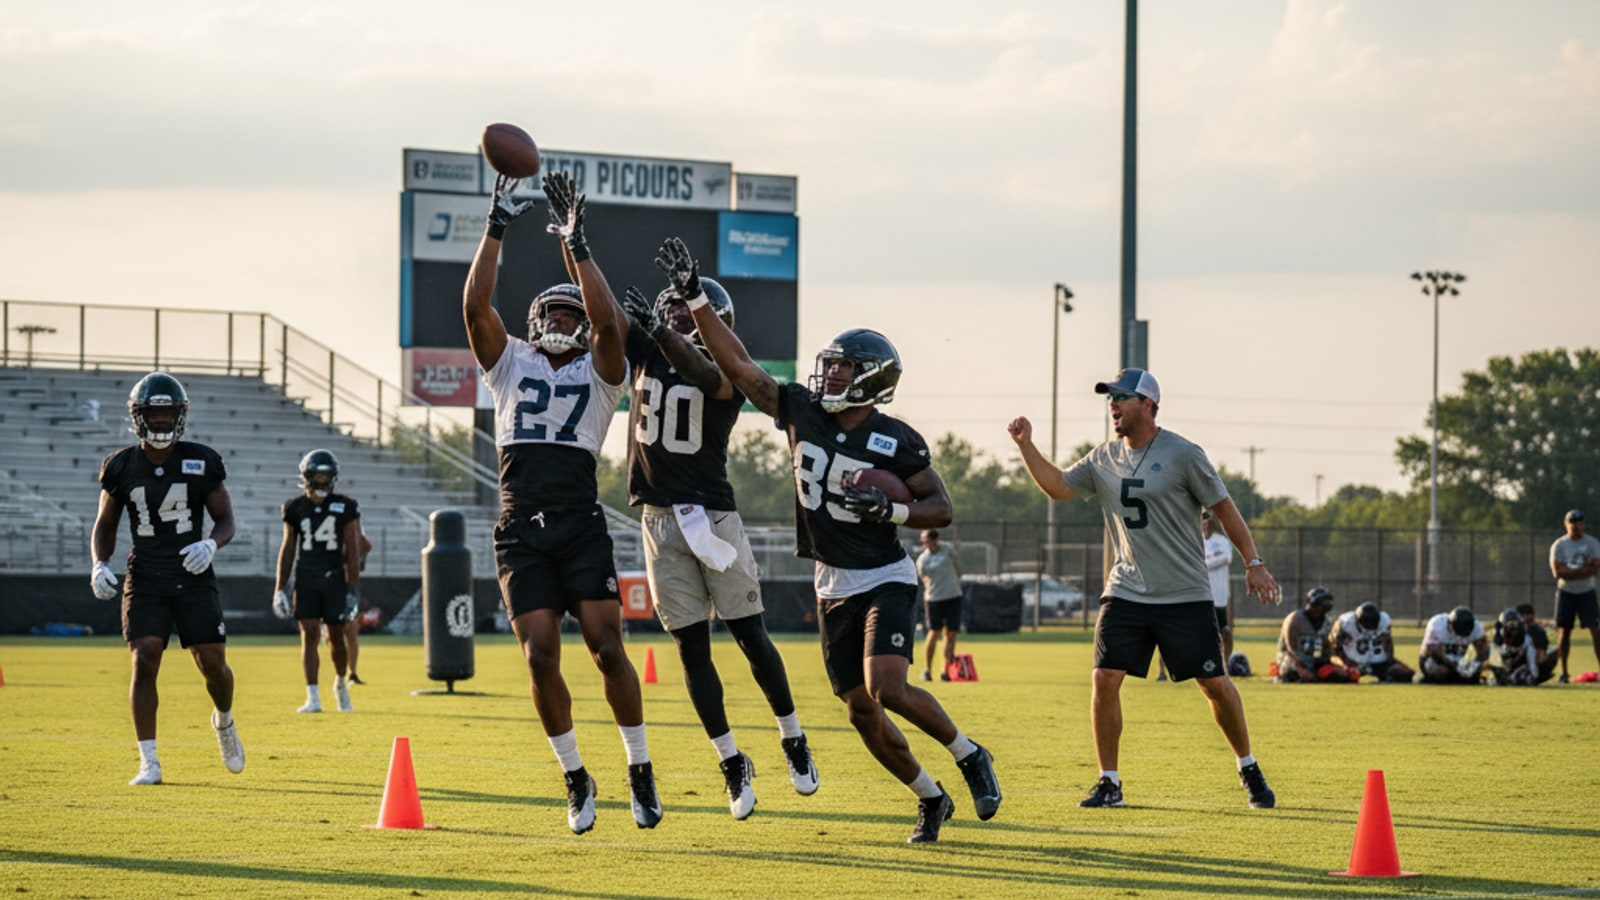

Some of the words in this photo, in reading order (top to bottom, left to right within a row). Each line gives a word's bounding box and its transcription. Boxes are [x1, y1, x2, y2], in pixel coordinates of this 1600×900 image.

[597, 160, 694, 201] PICOURS
[513, 376, 590, 442] 27
[635, 376, 704, 455] 30
[129, 482, 193, 537] 14
[1120, 478, 1148, 529] 5
[301, 515, 339, 550] 14
